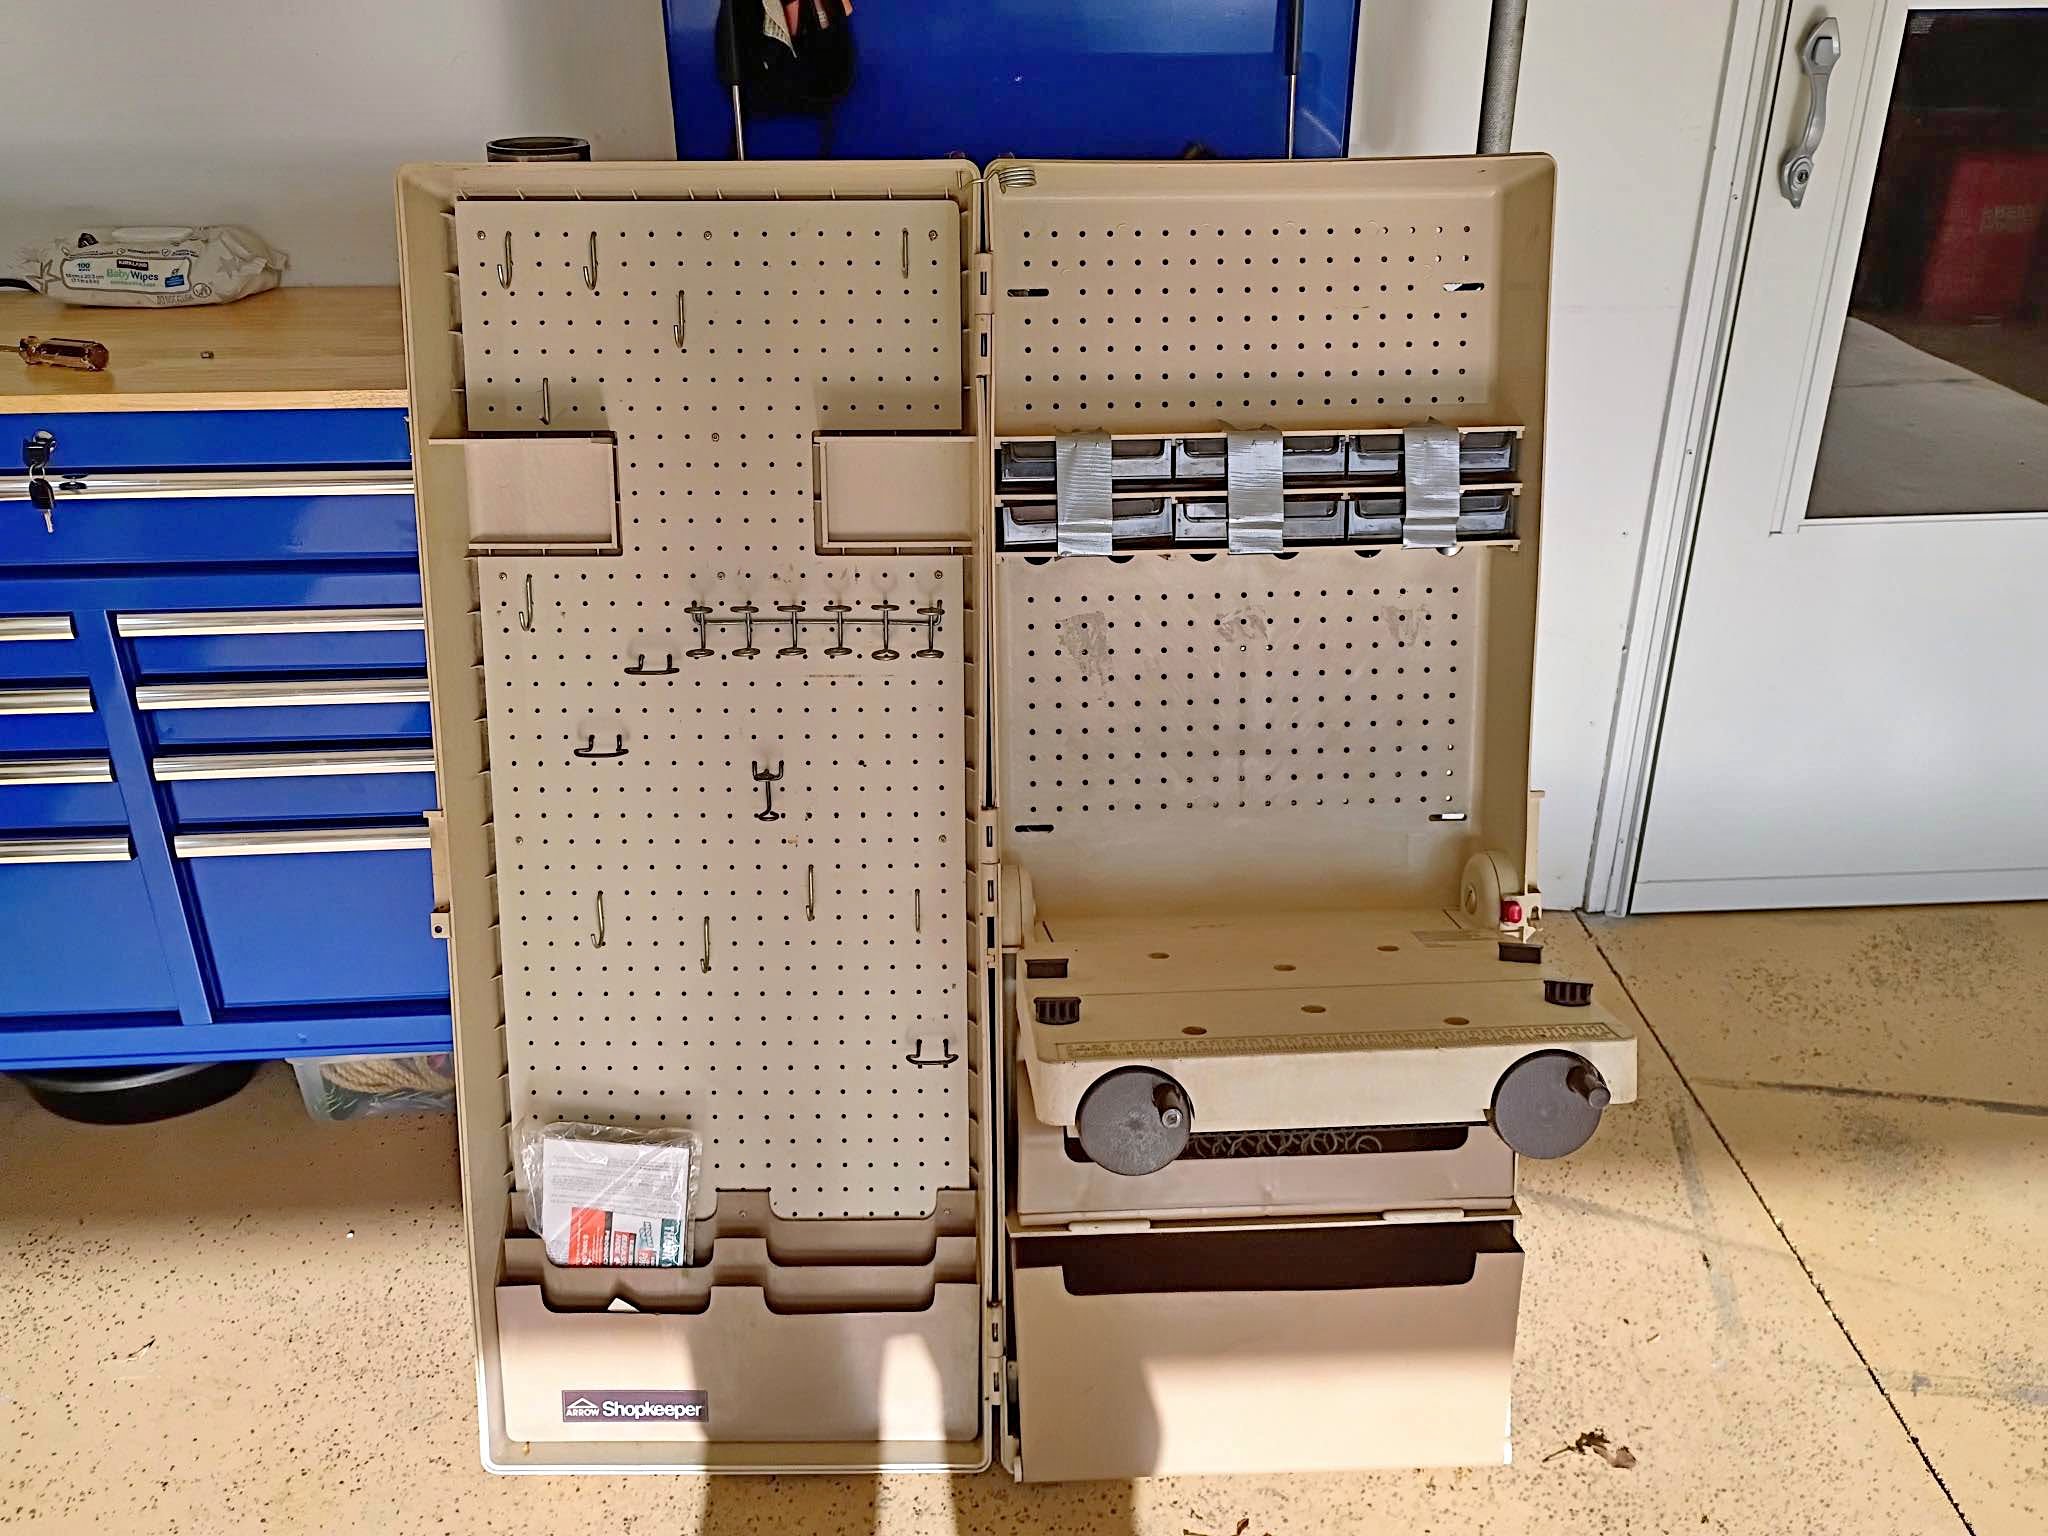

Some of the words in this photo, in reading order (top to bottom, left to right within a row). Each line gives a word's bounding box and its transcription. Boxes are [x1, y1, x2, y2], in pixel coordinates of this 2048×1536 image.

[107, 268, 129, 280] Baby
[130, 270, 159, 282] Wipes
[566, 1408, 600, 1417] ARROW
[602, 1400, 702, 1420] Shopkeeper
